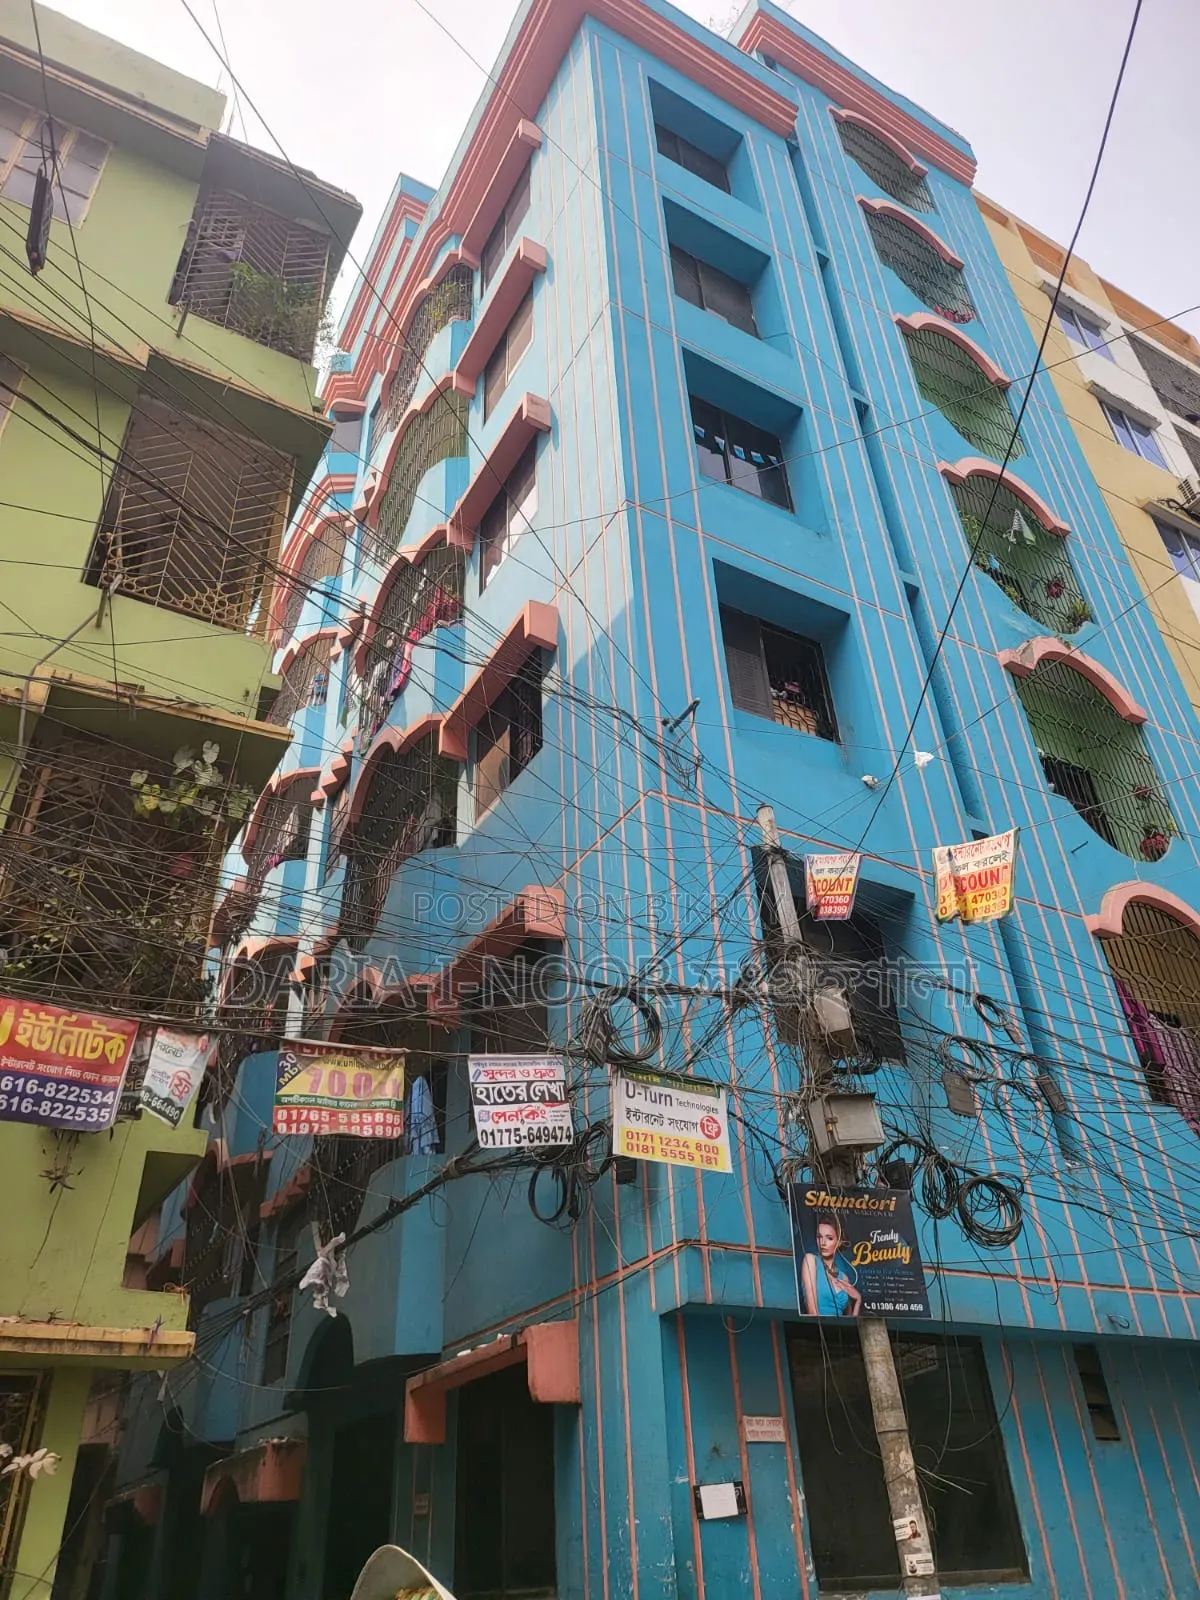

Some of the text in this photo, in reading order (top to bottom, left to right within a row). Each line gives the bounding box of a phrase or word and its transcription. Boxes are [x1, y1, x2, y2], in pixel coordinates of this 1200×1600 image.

[14, 1008, 127, 1065] ইউনিটেক
[279, 1052, 297, 1072] 30
[482, 1068, 556, 1080] সুন্দর ও দ্রুত
[306, 1065, 373, 1100] 700
[473, 1081, 566, 1105] হাতের লেখা
[625, 1081, 673, 1107] U-Turn
[675, 1097, 719, 1115] Technologies
[625, 1106, 665, 1127] ইন্টারনেট
[667, 1117, 698, 1134] সংযোগ
[480, 1126, 572, 1146] 01775-649474
[625, 1130, 719, 1156] 0171 1234 800
[625, 1142, 719, 1167] 0181 5555 181
[804, 1190, 897, 1212] Shundori
[869, 1228, 899, 1244] Trendy
[851, 1241, 912, 1267] Beauty
